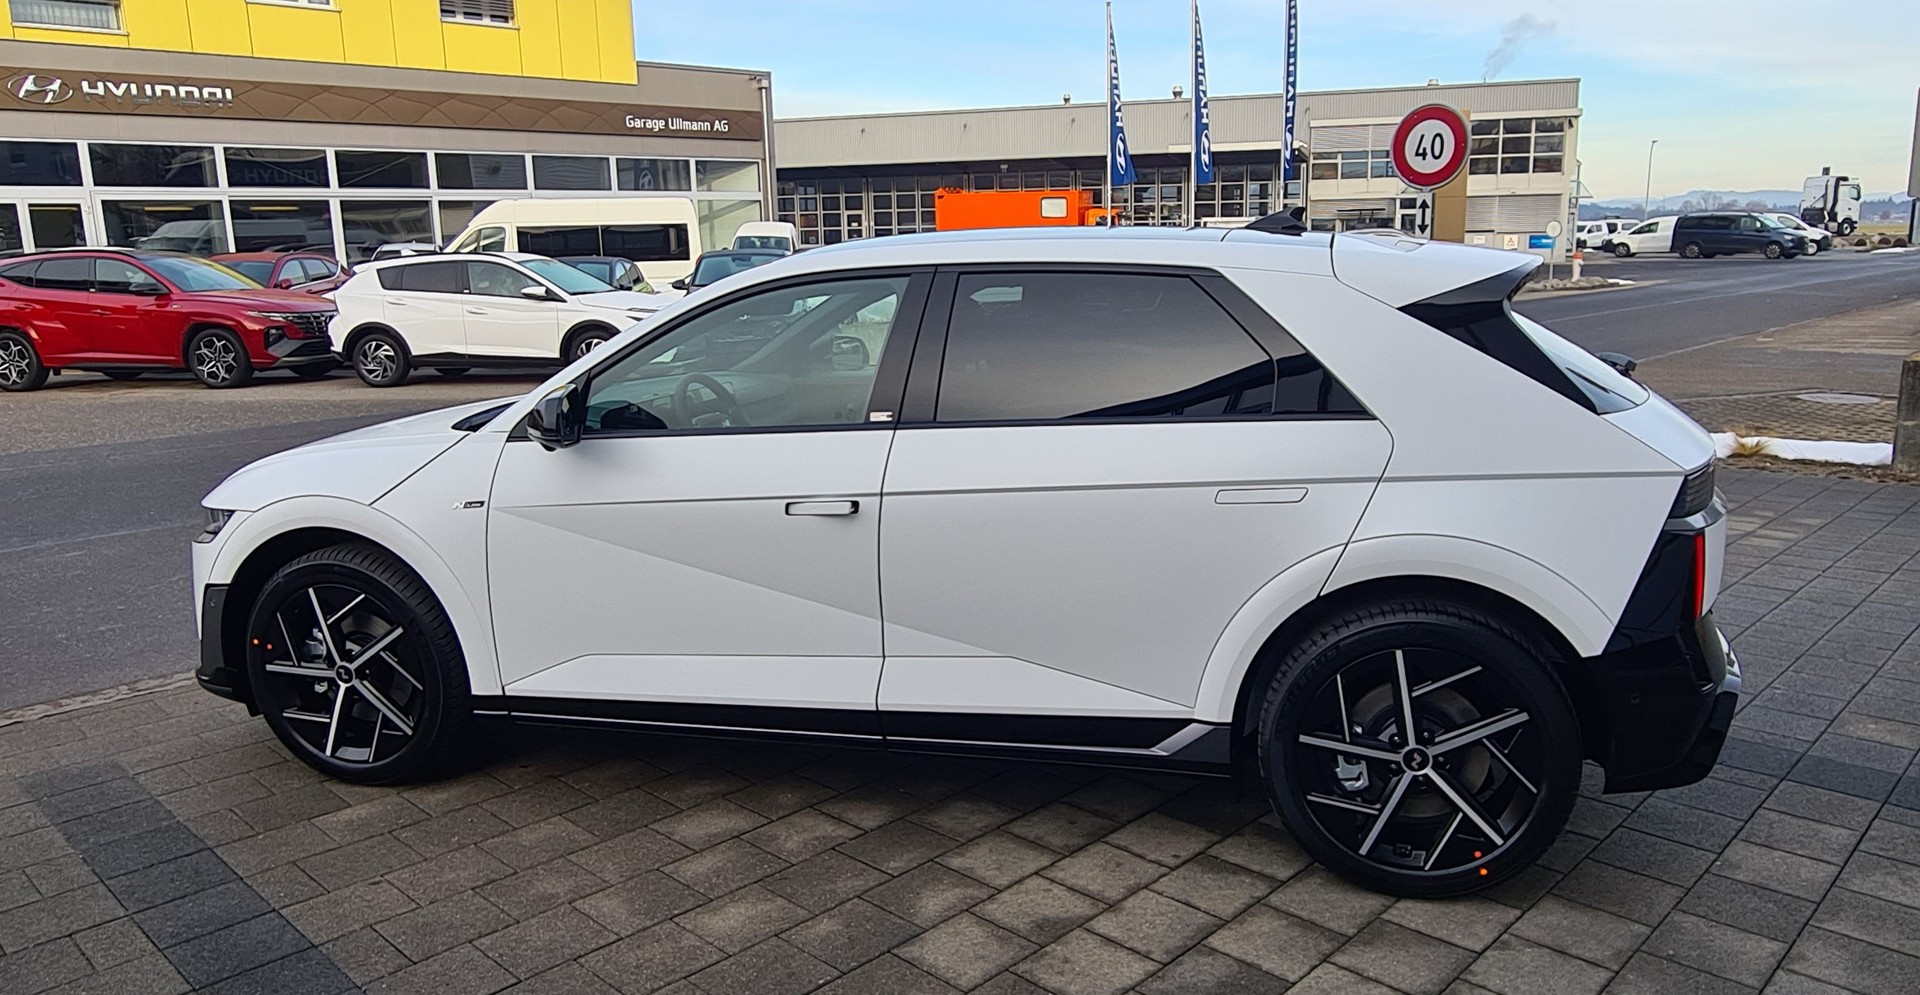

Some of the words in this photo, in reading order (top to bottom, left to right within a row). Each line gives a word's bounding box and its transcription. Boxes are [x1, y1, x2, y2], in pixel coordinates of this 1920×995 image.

[81, 80, 234, 108] HYUNDAI
[625, 115, 666, 132] Garage
[668, 117, 711, 132] Ullmann
[713, 119, 729, 132] AG
[1414, 132, 1445, 161] 40
